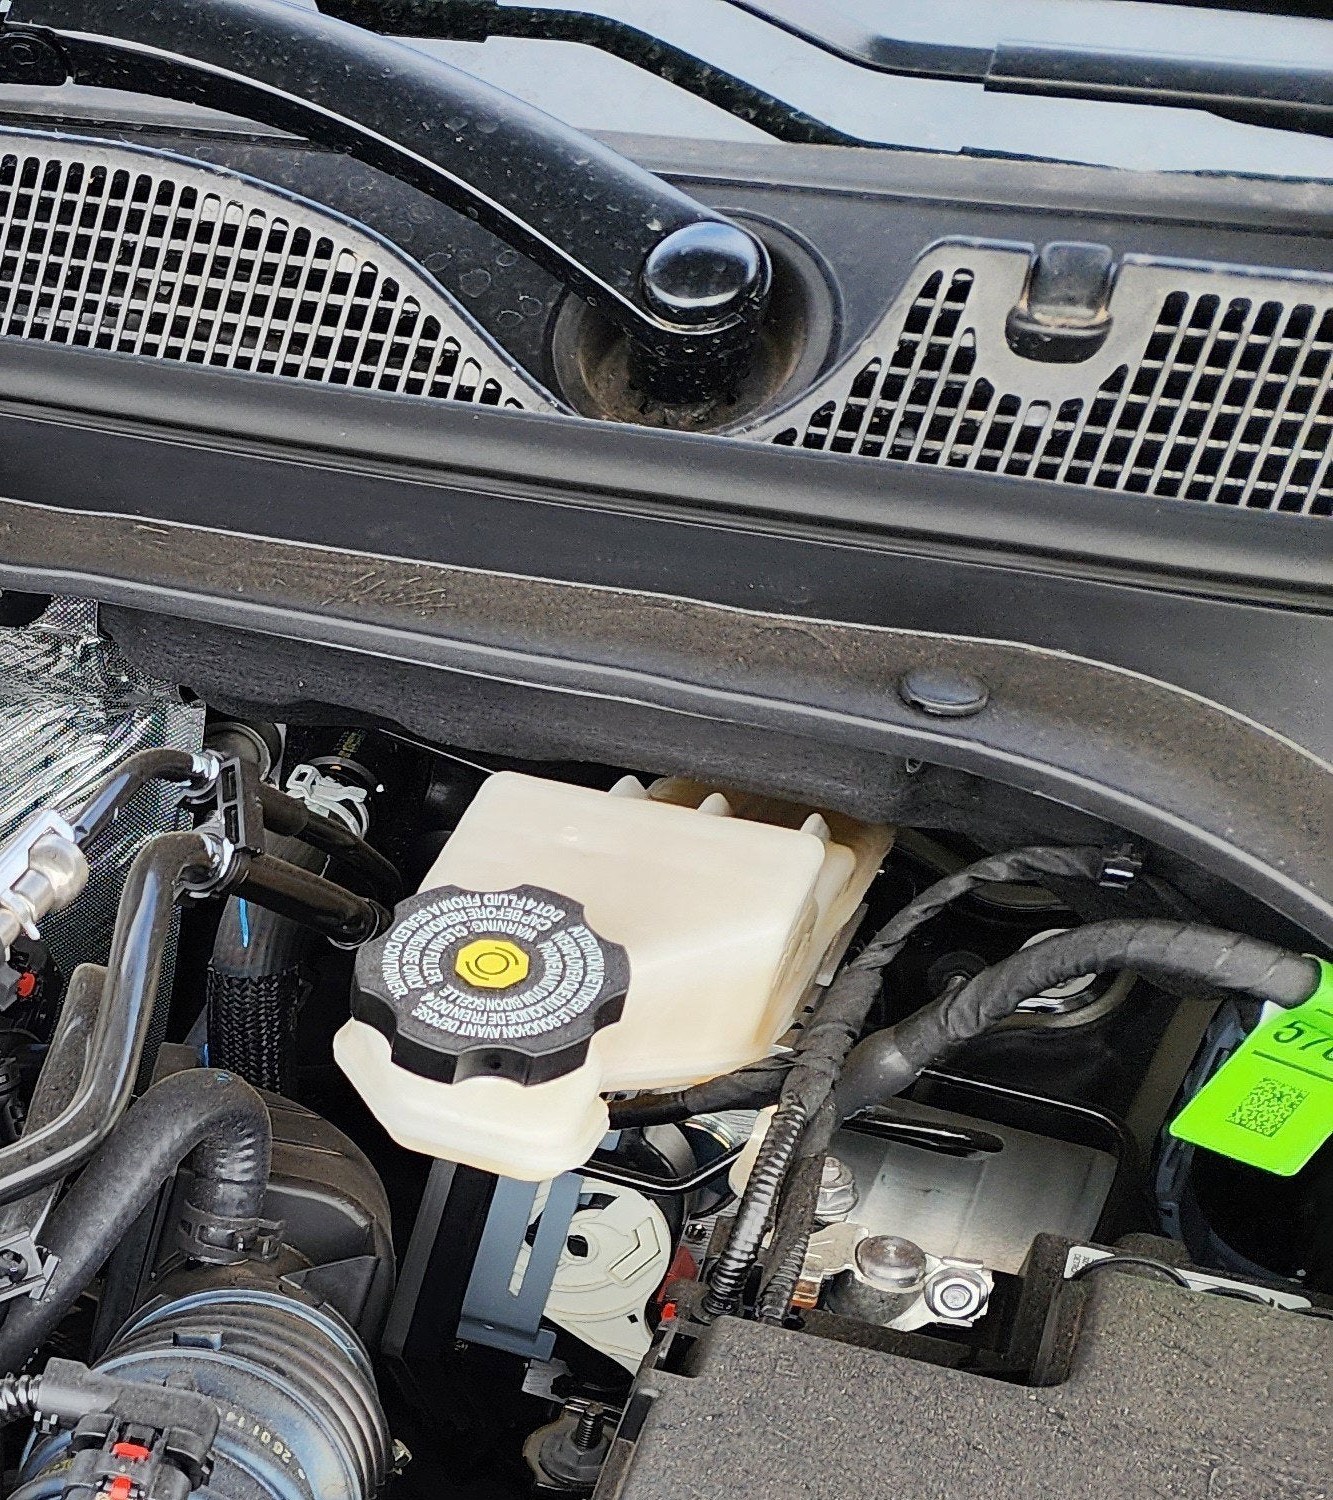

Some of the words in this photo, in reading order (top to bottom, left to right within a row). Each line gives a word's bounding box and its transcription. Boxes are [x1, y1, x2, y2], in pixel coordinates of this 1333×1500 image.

[435, 893, 482, 914] FROM
[481, 892, 529, 908] FLUID
[464, 905, 525, 921] BEFORE
[531, 899, 569, 922] DOT
[388, 908, 434, 943] SEALED
[519, 911, 555, 931] CAP
[421, 949, 448, 985] FILLER
[401, 964, 428, 992] ONLY
[425, 996, 455, 1015] DOT
[455, 1022, 502, 1038] AVANT
